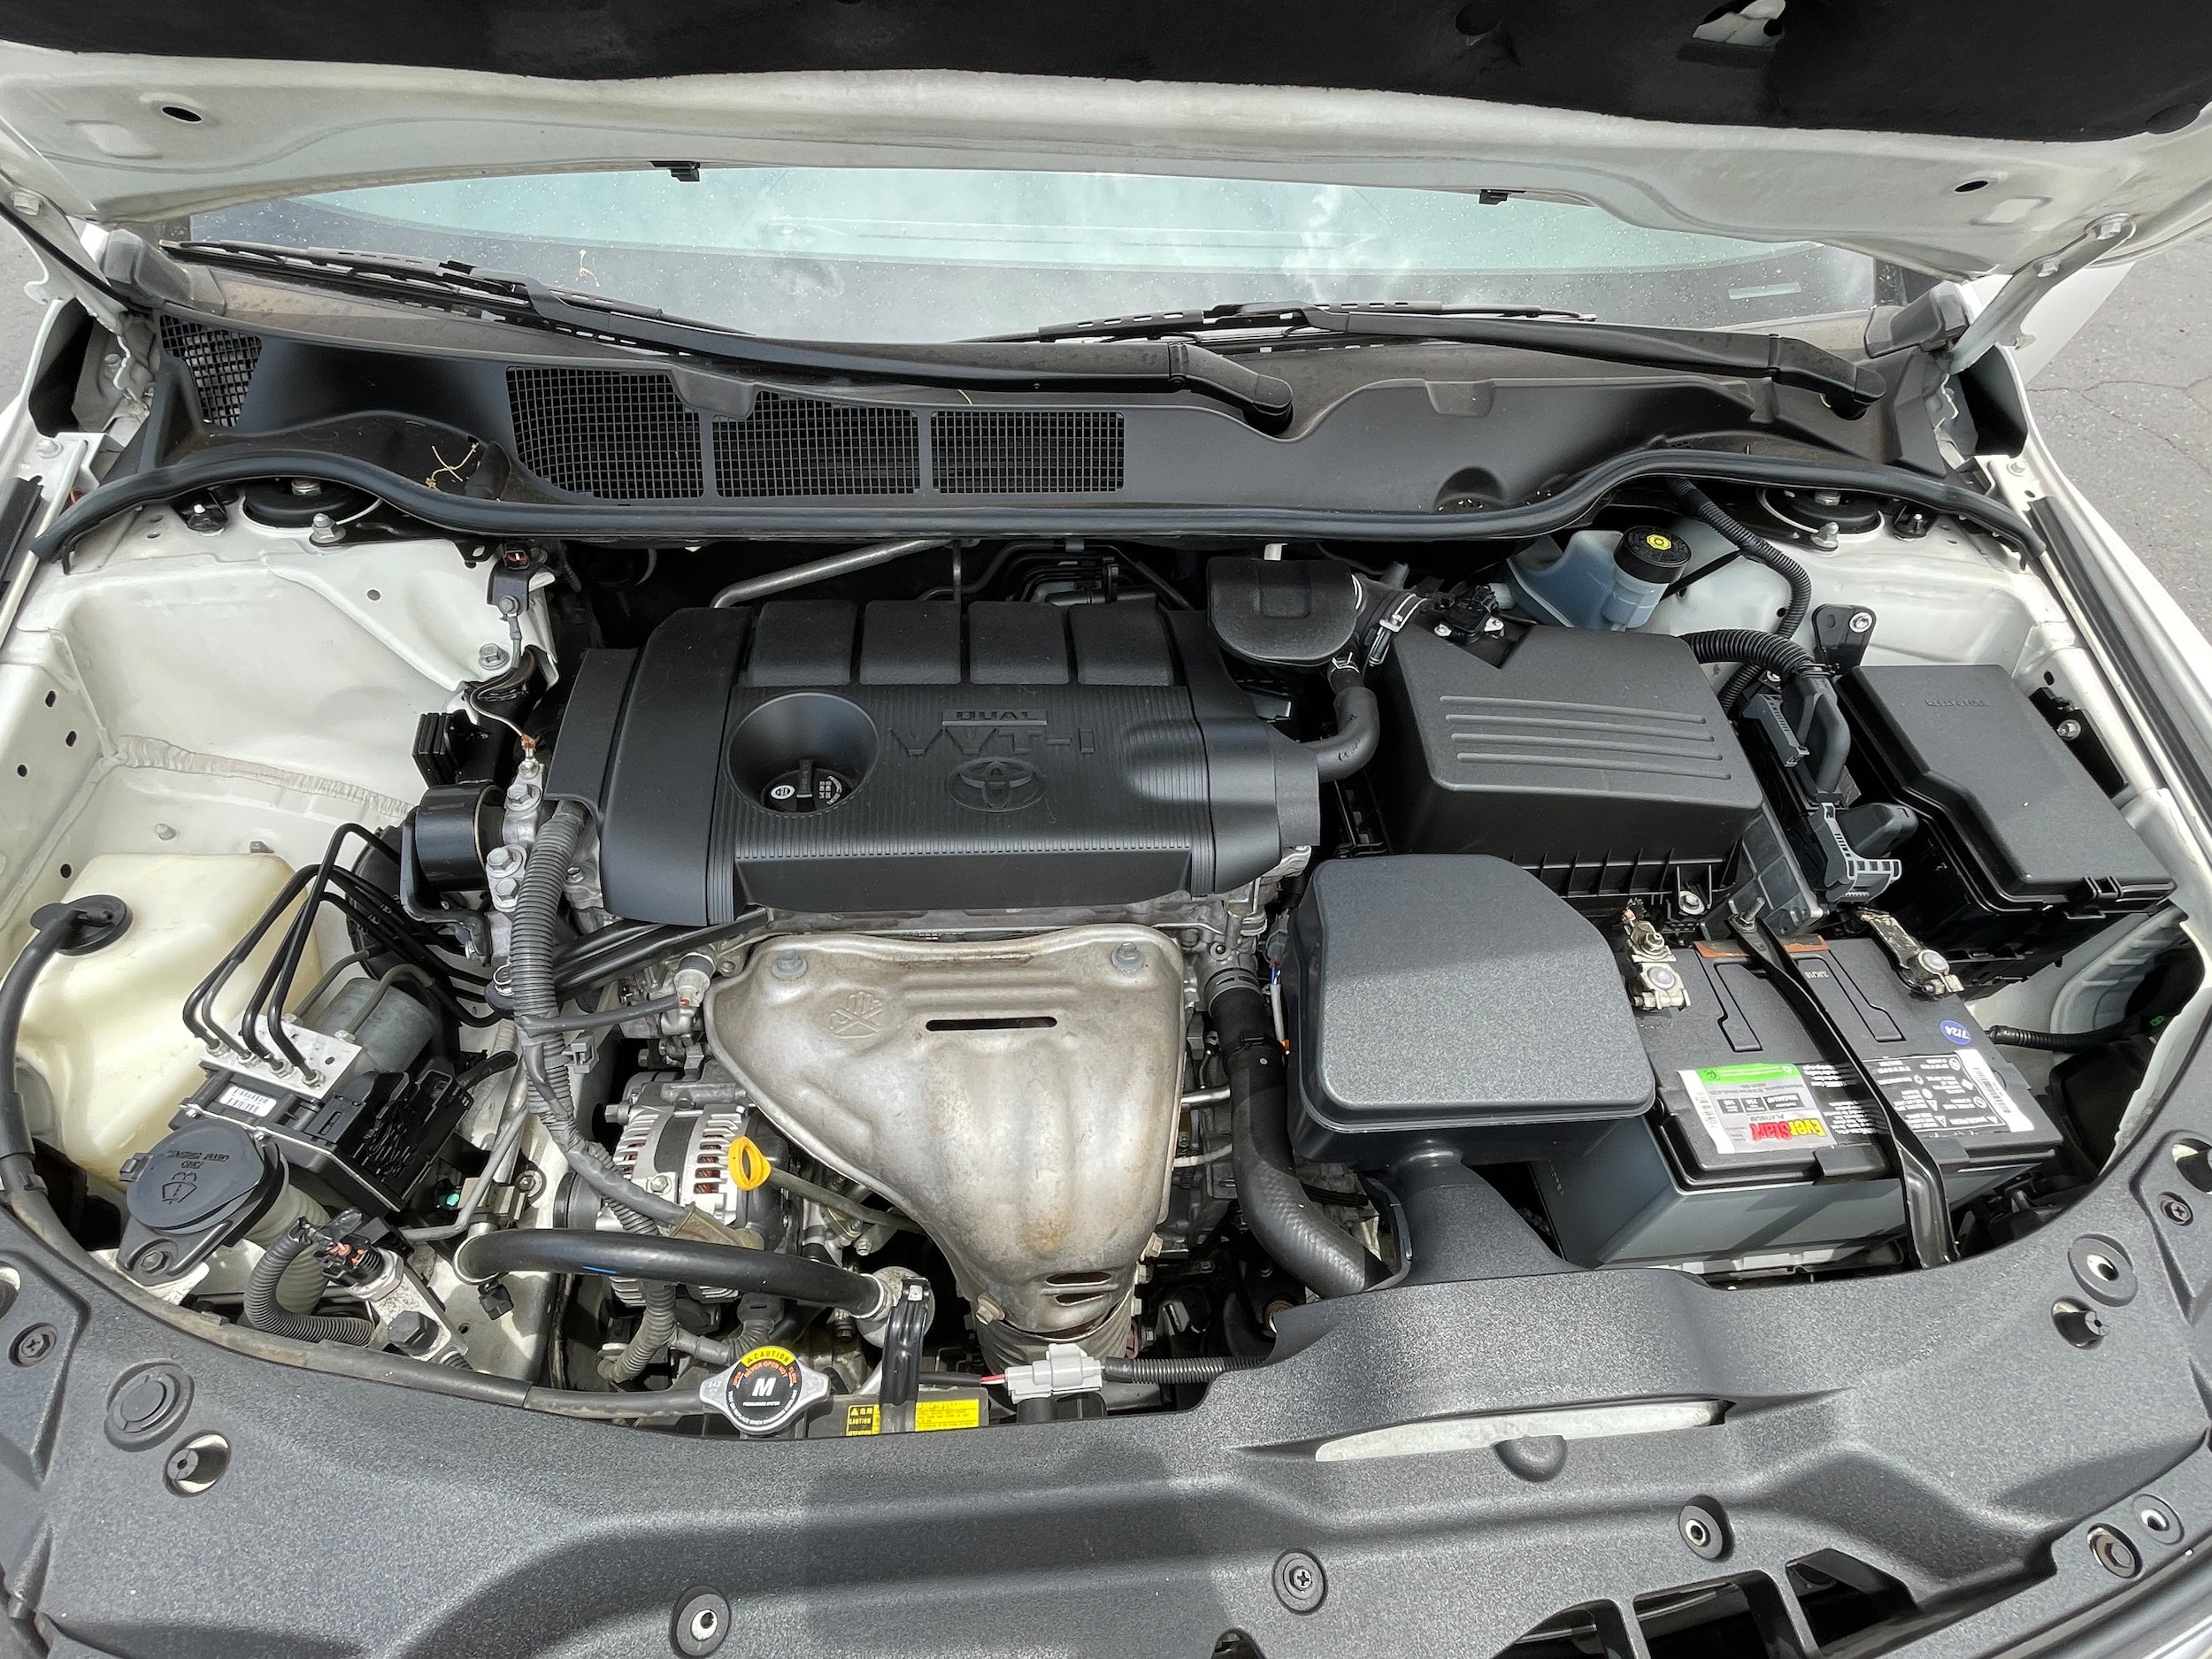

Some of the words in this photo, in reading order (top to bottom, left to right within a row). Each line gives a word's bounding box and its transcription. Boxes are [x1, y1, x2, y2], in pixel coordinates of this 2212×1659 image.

[956, 710, 1038, 720] DUAL
[1749, 1117, 1826, 1141] EverStart
[754, 1350, 790, 1363] CAUTION
